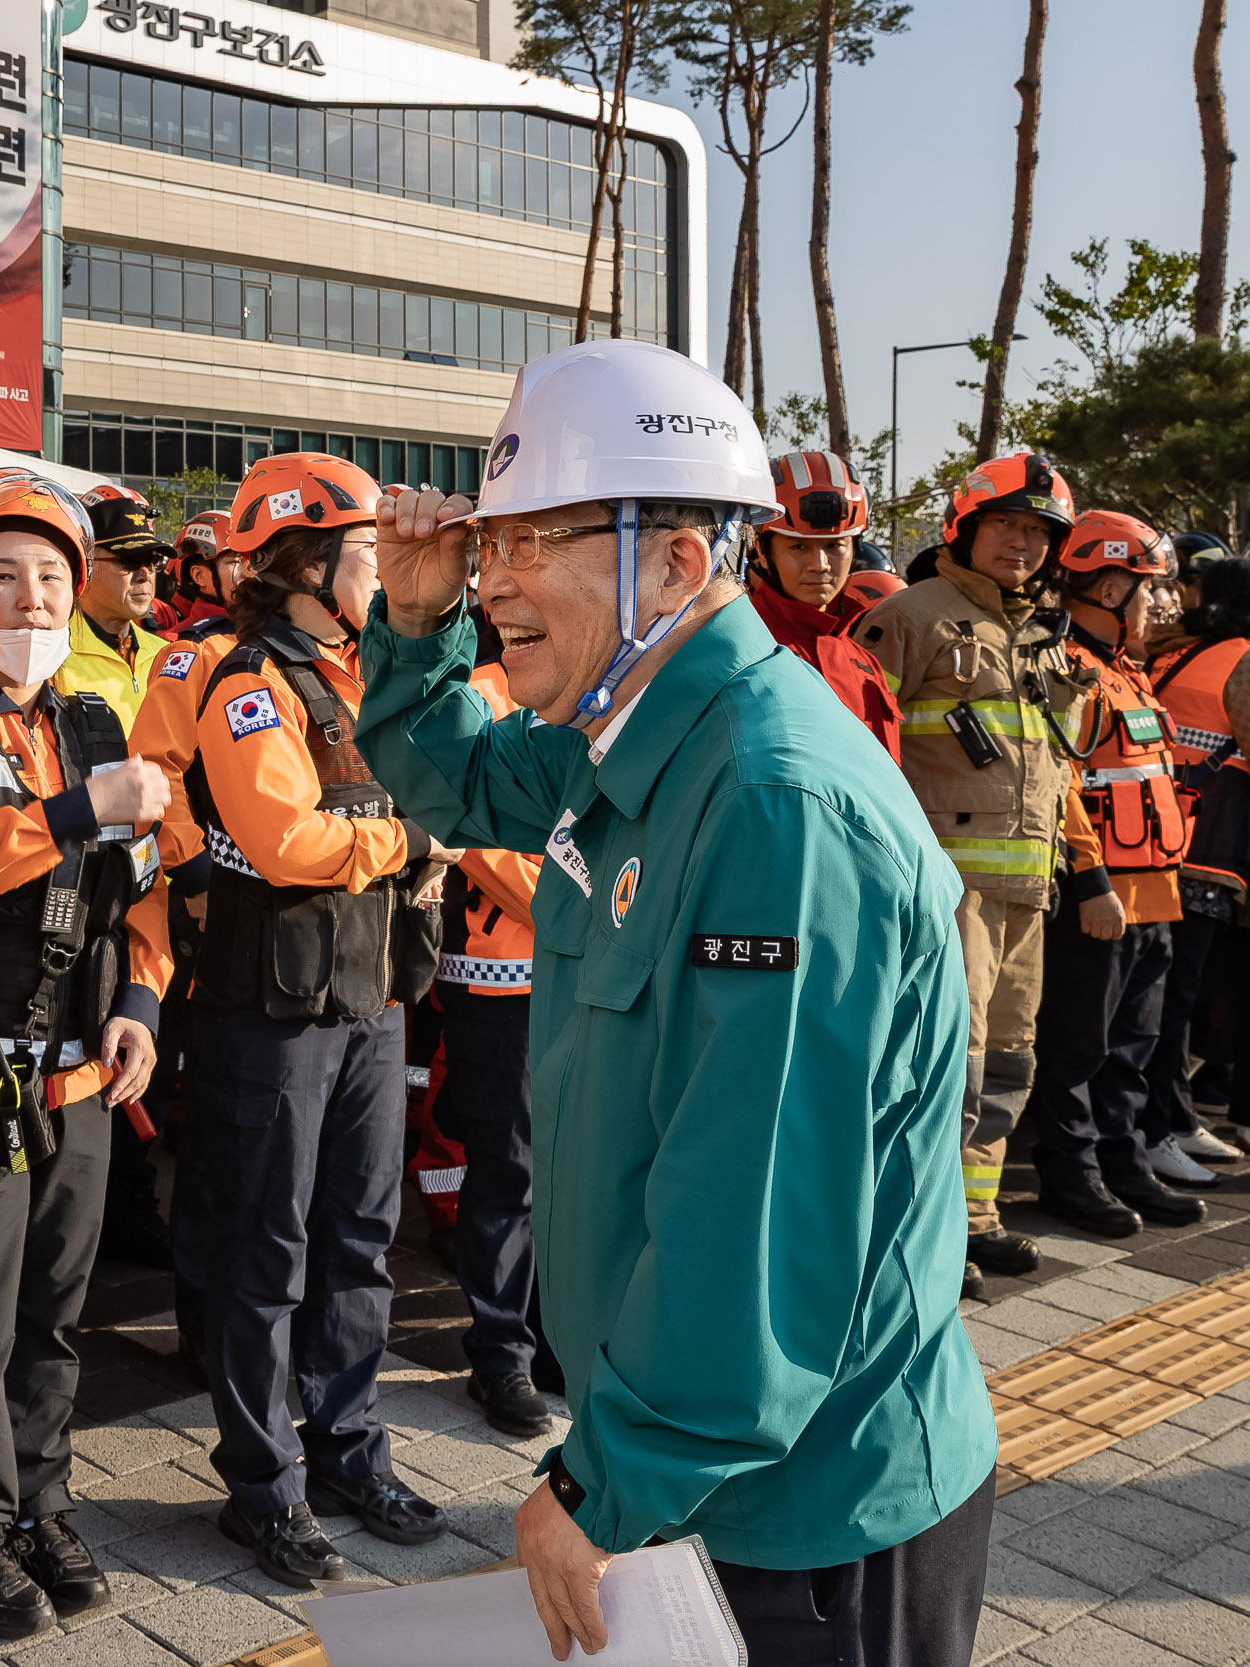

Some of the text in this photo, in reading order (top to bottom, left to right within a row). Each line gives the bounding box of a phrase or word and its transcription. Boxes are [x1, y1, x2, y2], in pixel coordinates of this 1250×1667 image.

[9, 387, 30, 402] 사고
[635, 414, 740, 443] 광진구청
[237, 718, 275, 736] KOREA
